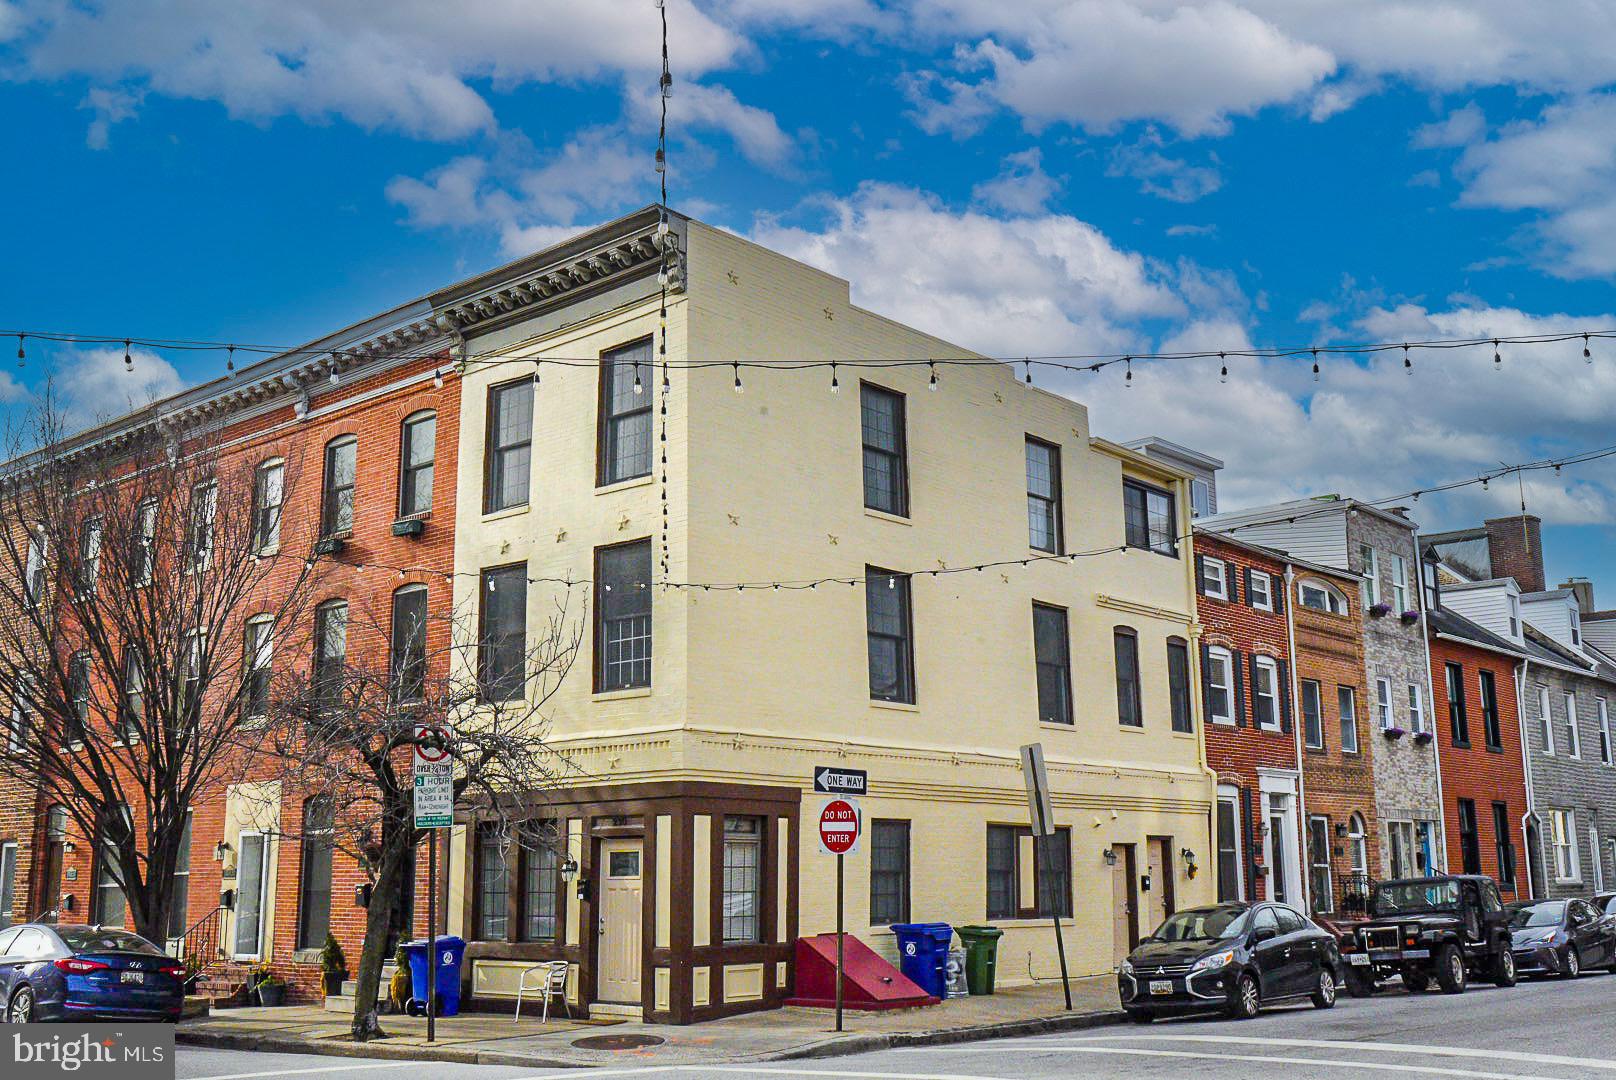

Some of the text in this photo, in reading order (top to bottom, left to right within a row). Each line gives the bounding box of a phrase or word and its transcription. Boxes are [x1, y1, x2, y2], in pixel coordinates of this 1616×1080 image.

[416, 764, 430, 773] OVER
[427, 777, 450, 785] HOUR
[827, 775, 862, 788] ONE WAY
[824, 811, 852, 819] DO NOT
[827, 834, 849, 843] ENTER
